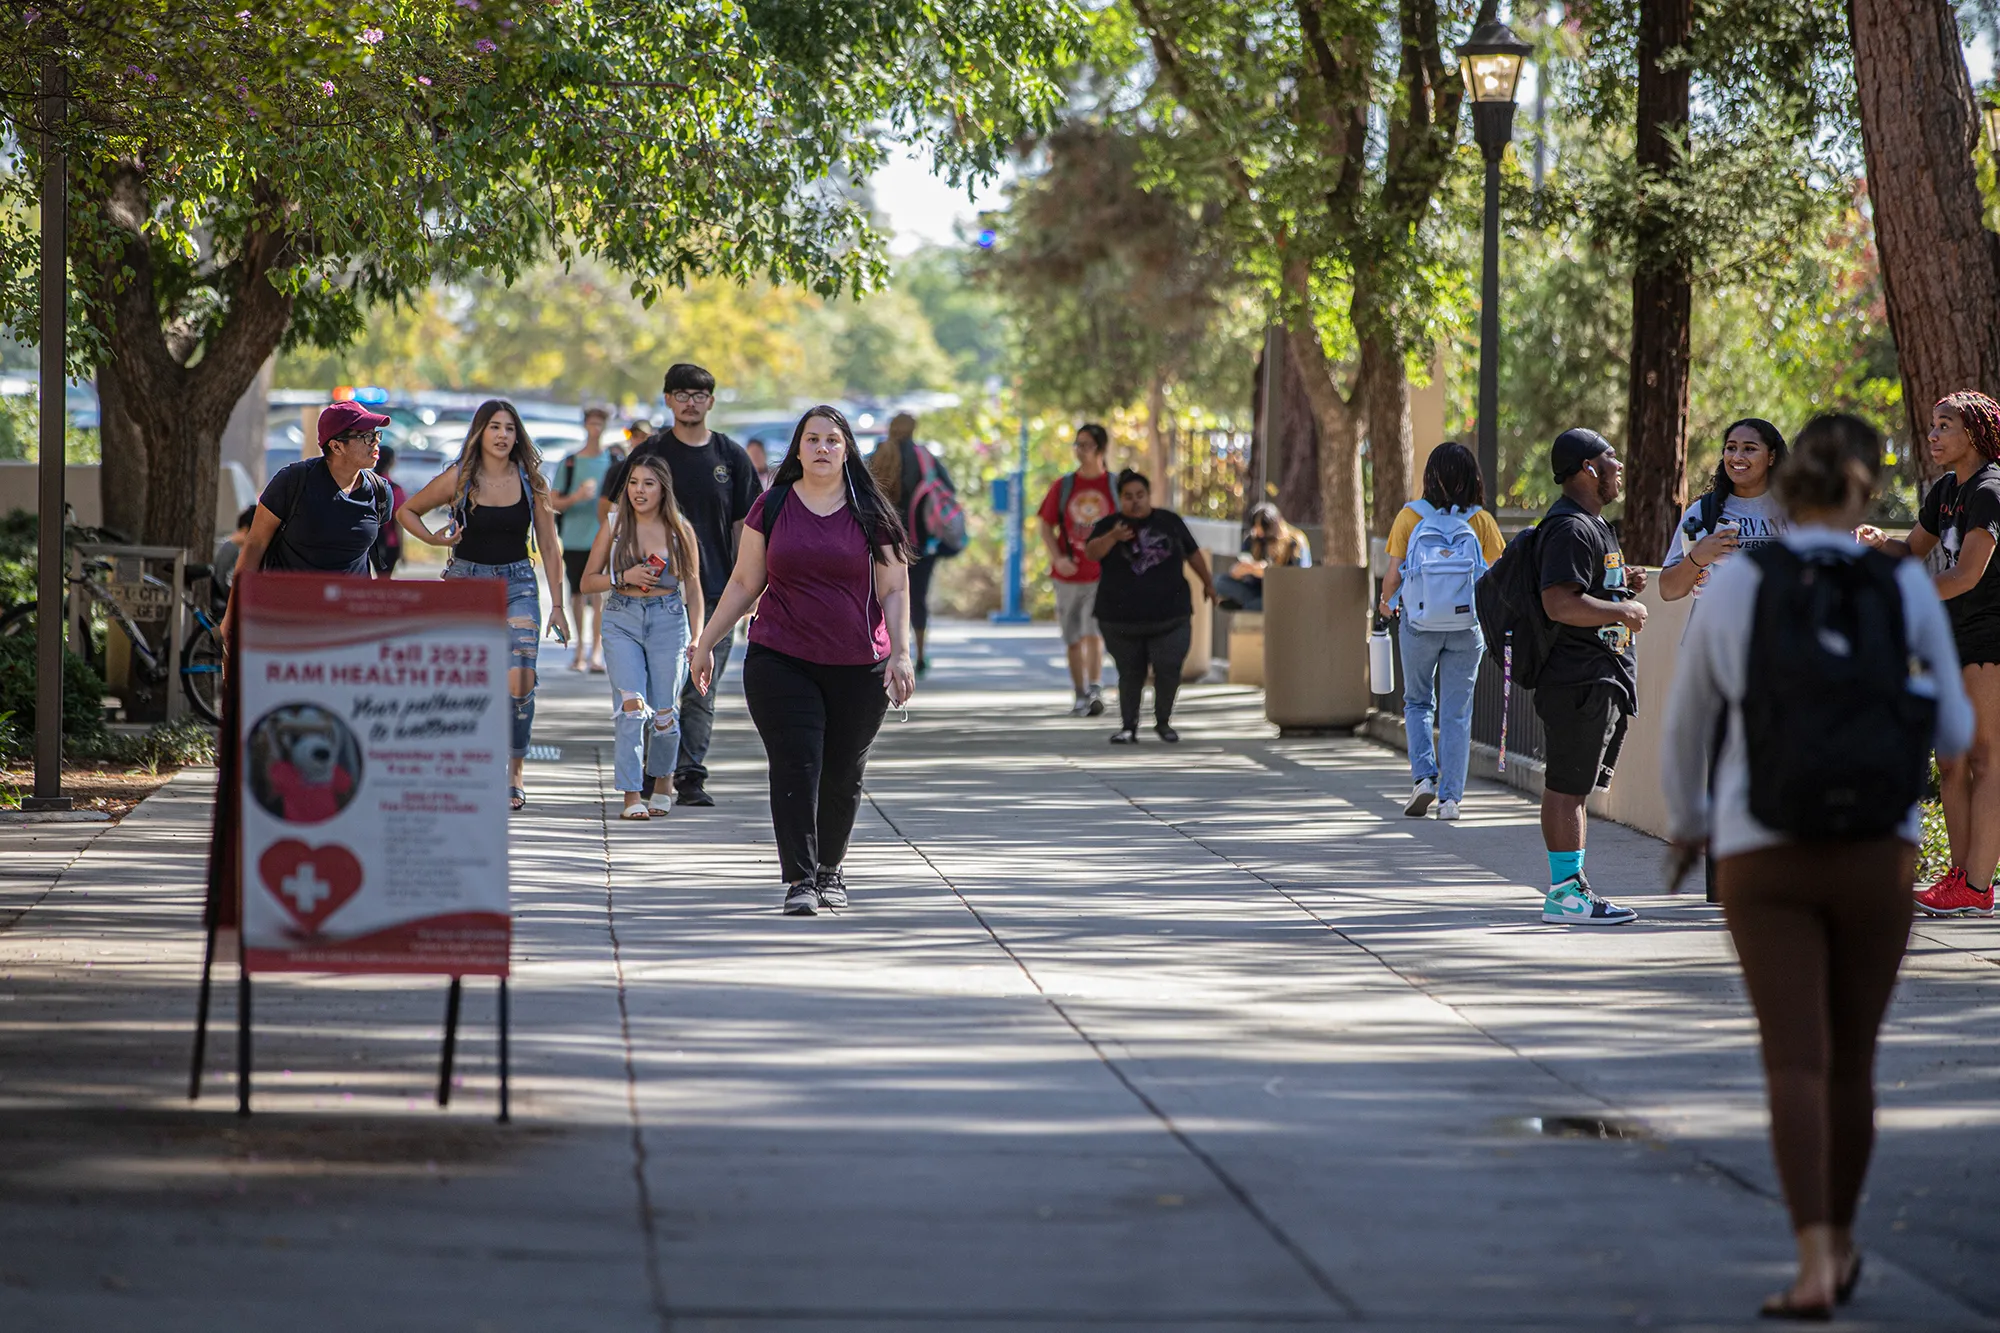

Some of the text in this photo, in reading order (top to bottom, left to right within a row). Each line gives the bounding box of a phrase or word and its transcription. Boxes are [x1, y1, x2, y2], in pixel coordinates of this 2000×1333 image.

[1733, 516, 1790, 537] RVANA
[379, 644, 488, 666] Fall 2022
[266, 664, 489, 687] RAM HEALTH FAIR
